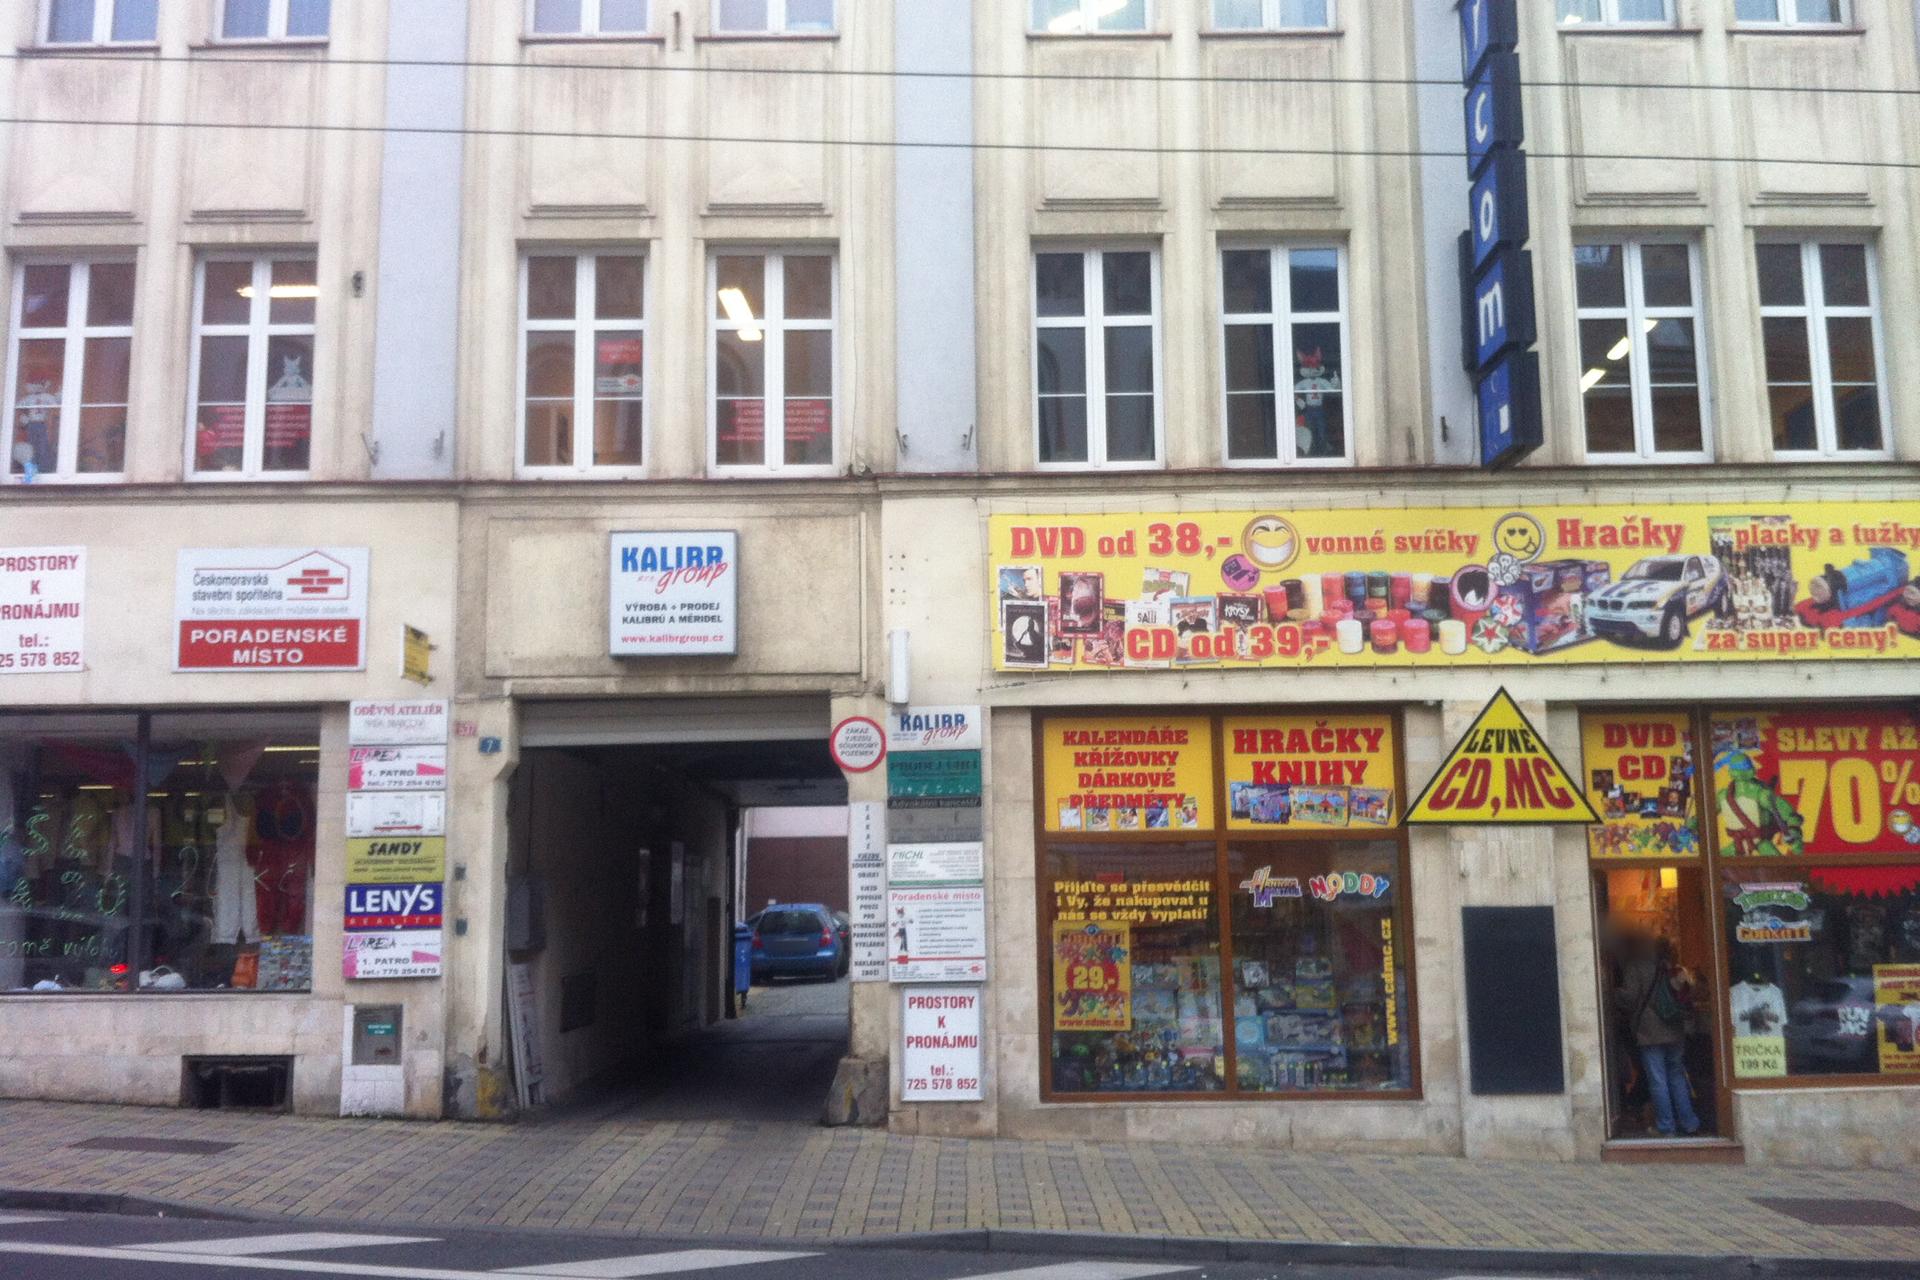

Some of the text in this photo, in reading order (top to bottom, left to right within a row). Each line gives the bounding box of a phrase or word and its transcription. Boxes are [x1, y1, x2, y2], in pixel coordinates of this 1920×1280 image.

[1010, 522, 1233, 560] DVD od 38,-
[1305, 527, 1481, 557] vonné svíčky
[1556, 515, 1686, 554] Hračky
[1735, 523, 1820, 551] placky
[1829, 527, 1845, 545] a
[621, 546, 724, 573] KALIBR
[30, 580, 41, 595] K
[193, 571, 269, 586] Českomoravská
[655, 562, 728, 594] group
[0, 600, 80, 620] RONÁJMU
[625, 601, 667, 612] VÝROBA
[680, 602, 720, 611] PRODEJ
[19, 634, 49, 648] tel.:
[190, 626, 348, 645] PORADENSKÉ
[1127, 628, 1177, 660] CD
[1191, 627, 1237, 658] od
[1706, 625, 1899, 654] za super ceny!
[0, 652, 80, 668] 25 578 852
[232, 647, 303, 665] MÍSTO
[901, 713, 965, 731] KALIBR
[922, 724, 968, 745] group
[1063, 726, 1189, 746] KALENDÁŘE
[1233, 722, 1386, 754] HRAČKY
[1462, 724, 1540, 754] LEVNÉ
[1602, 722, 1677, 749] DVD
[1776, 726, 1869, 752] SLEVY
[1074, 747, 1179, 767] KŘÍŽOVKY
[1251, 760, 1368, 786] KNIHY
[1618, 755, 1667, 781] CD
[1078, 770, 1176, 788] DÁRKOVÉ
[1069, 792, 1186, 809] PŘEDMĚTY
[367, 842, 422, 855] SANDY
[892, 891, 981, 901] Poradenské místo
[1054, 880, 1210, 894] Přijďte se přesvědčit
[1309, 872, 1389, 901] NODDY
[350, 884, 434, 916] LENYS
[1094, 896, 1111, 906] že
[1116, 895, 1194, 908] nakupovat
[1199, 896, 1209, 905] u
[350, 917, 435, 925] REALITY
[1058, 908, 1208, 922] nás se vždy vyplatí!
[1072, 966, 1115, 991] 29,-
[908, 996, 975, 1010] PROSTORY
[937, 1016, 946, 1028] K
[906, 1033, 978, 1049] PRONÁJMU
[930, 1064, 954, 1076] tel.:
[907, 1079, 977, 1090] 725 578 852
